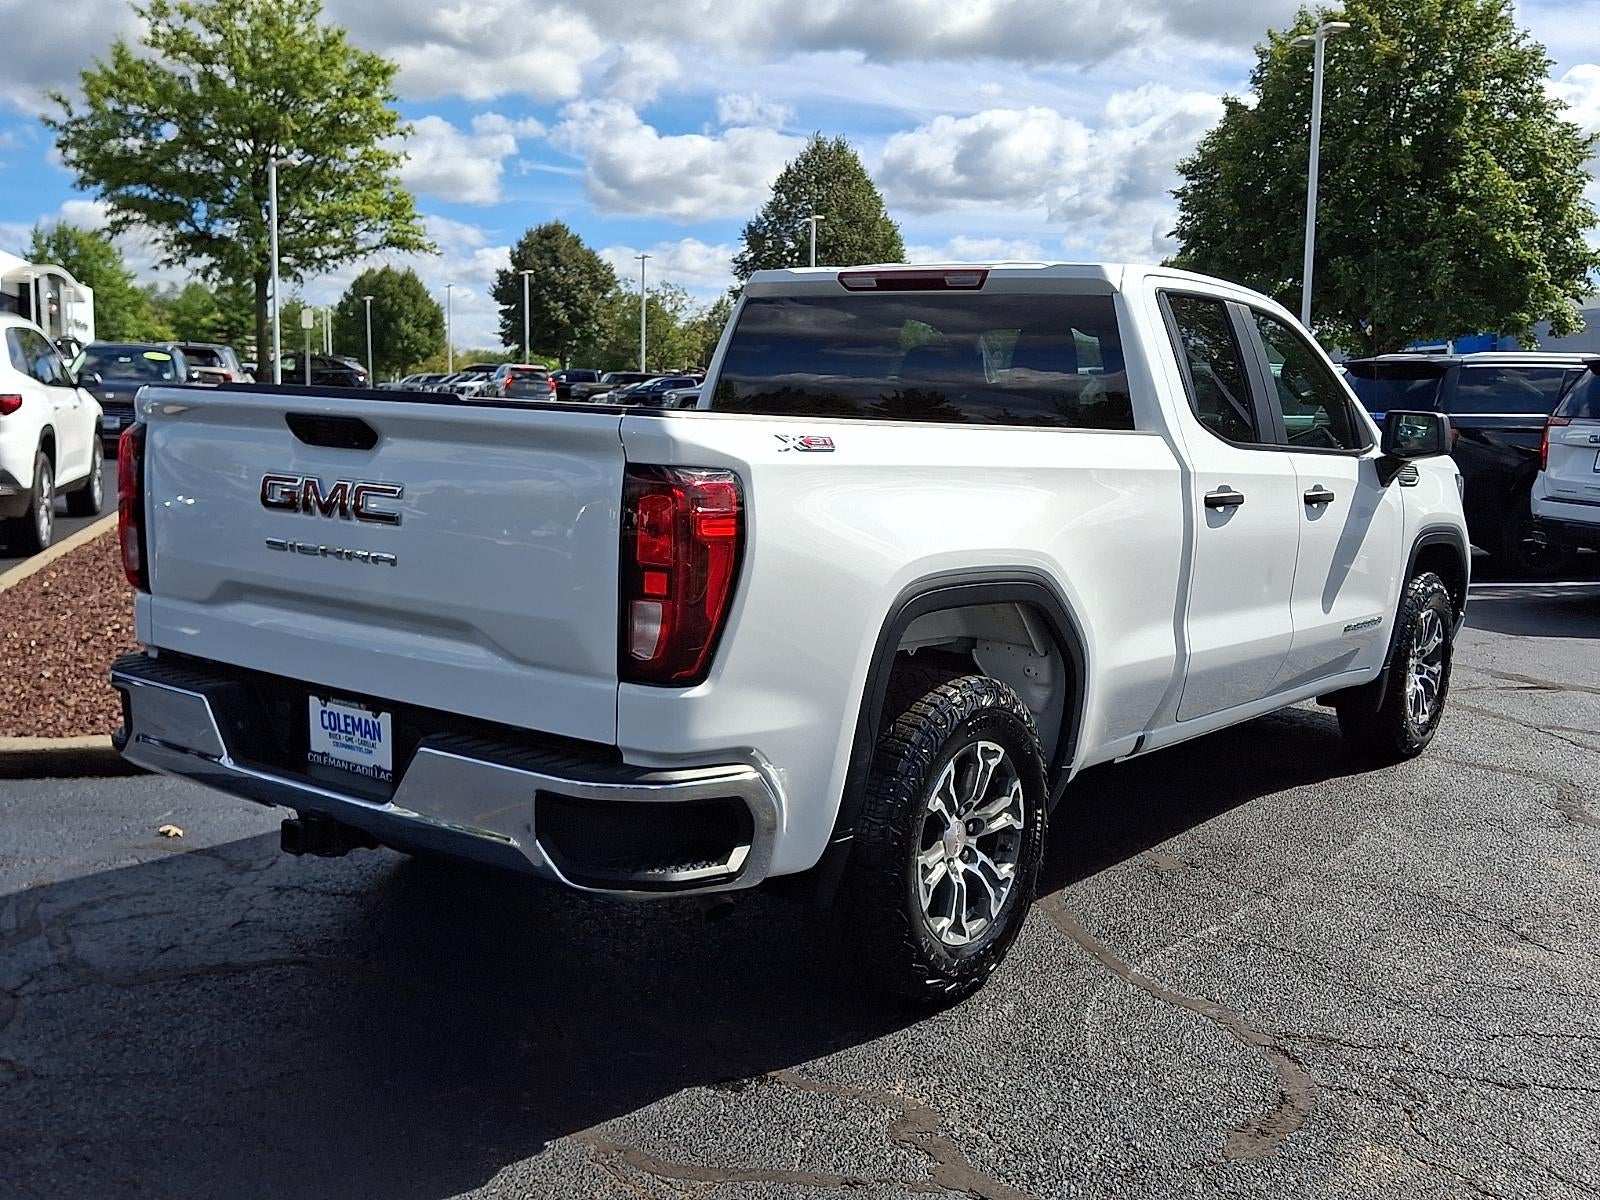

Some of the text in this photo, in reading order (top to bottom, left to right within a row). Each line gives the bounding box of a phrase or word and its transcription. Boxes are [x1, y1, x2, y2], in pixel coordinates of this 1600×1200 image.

[260, 472, 404, 527] GMC
[265, 537, 398, 567] SIERRA
[320, 709, 382, 743] COLEMAN
[307, 752, 393, 782] COLEMAN CADILLAC
